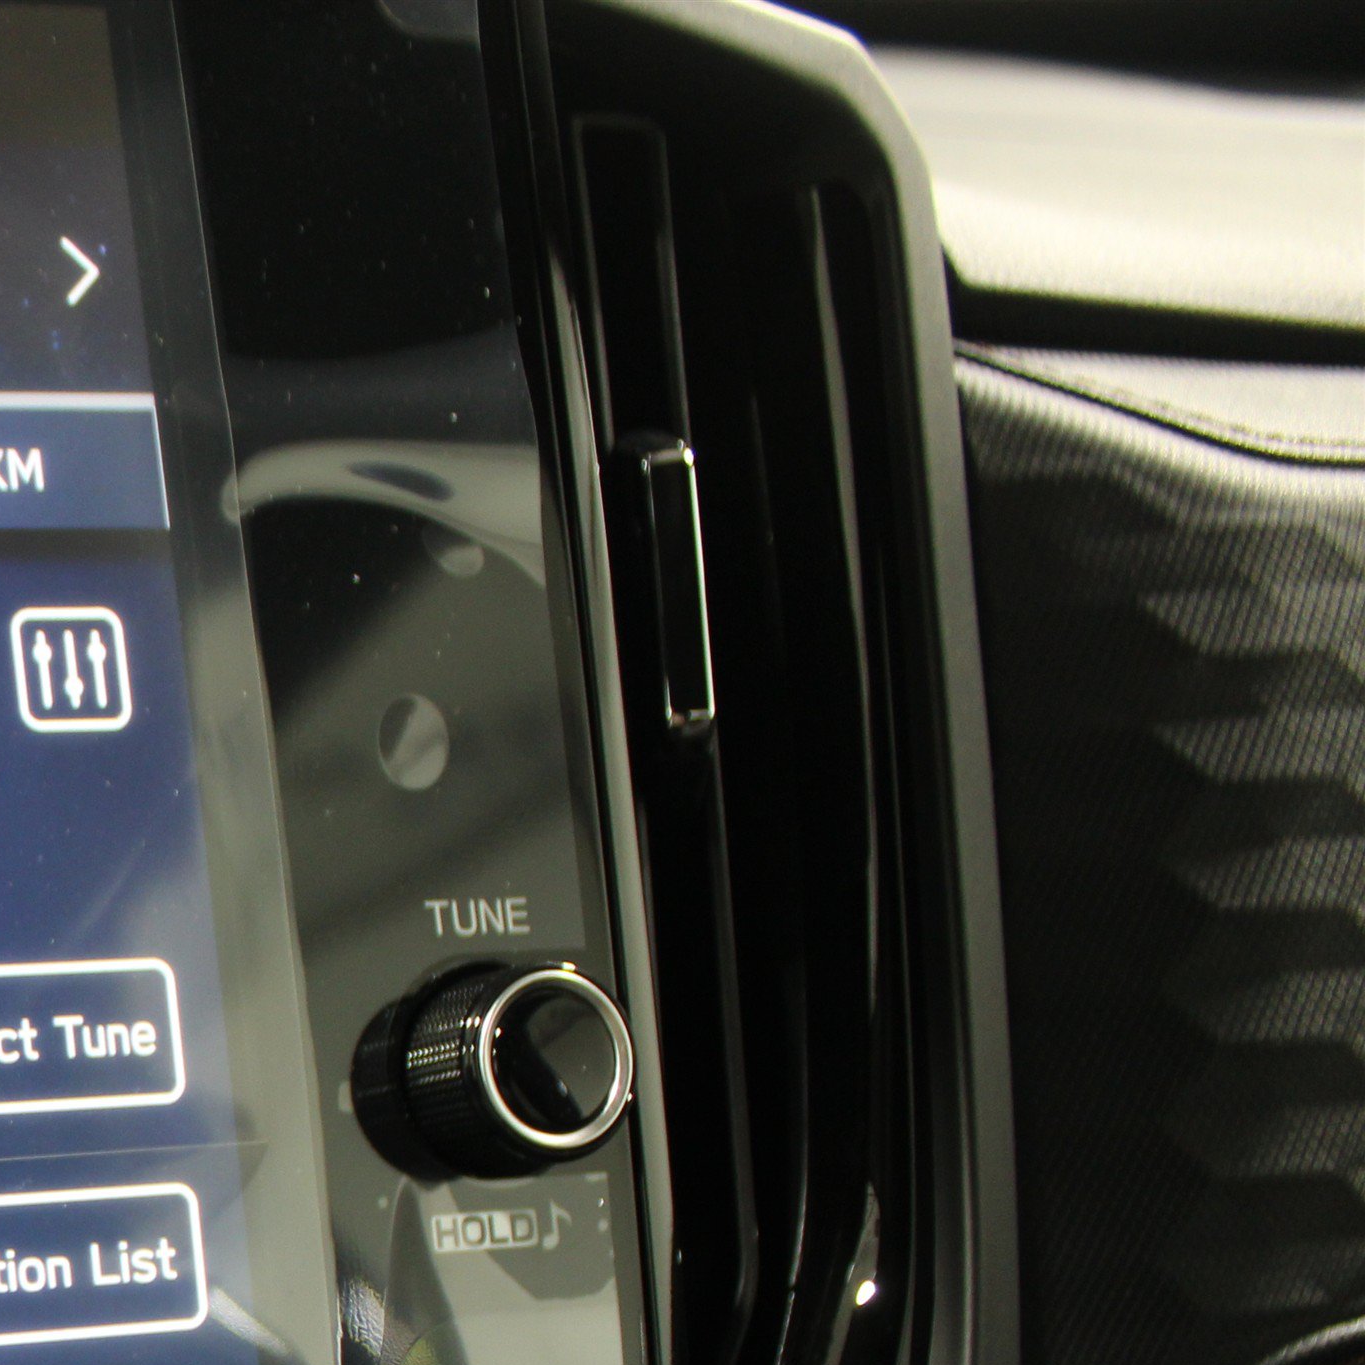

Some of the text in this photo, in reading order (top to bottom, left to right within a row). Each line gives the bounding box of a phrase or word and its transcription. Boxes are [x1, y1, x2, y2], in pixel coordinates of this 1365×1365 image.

[425, 897, 530, 938] TUNE
[53, 1014, 157, 1060] Tune
[435, 1211, 537, 1249] HOLD
[88, 1238, 178, 1285] List
